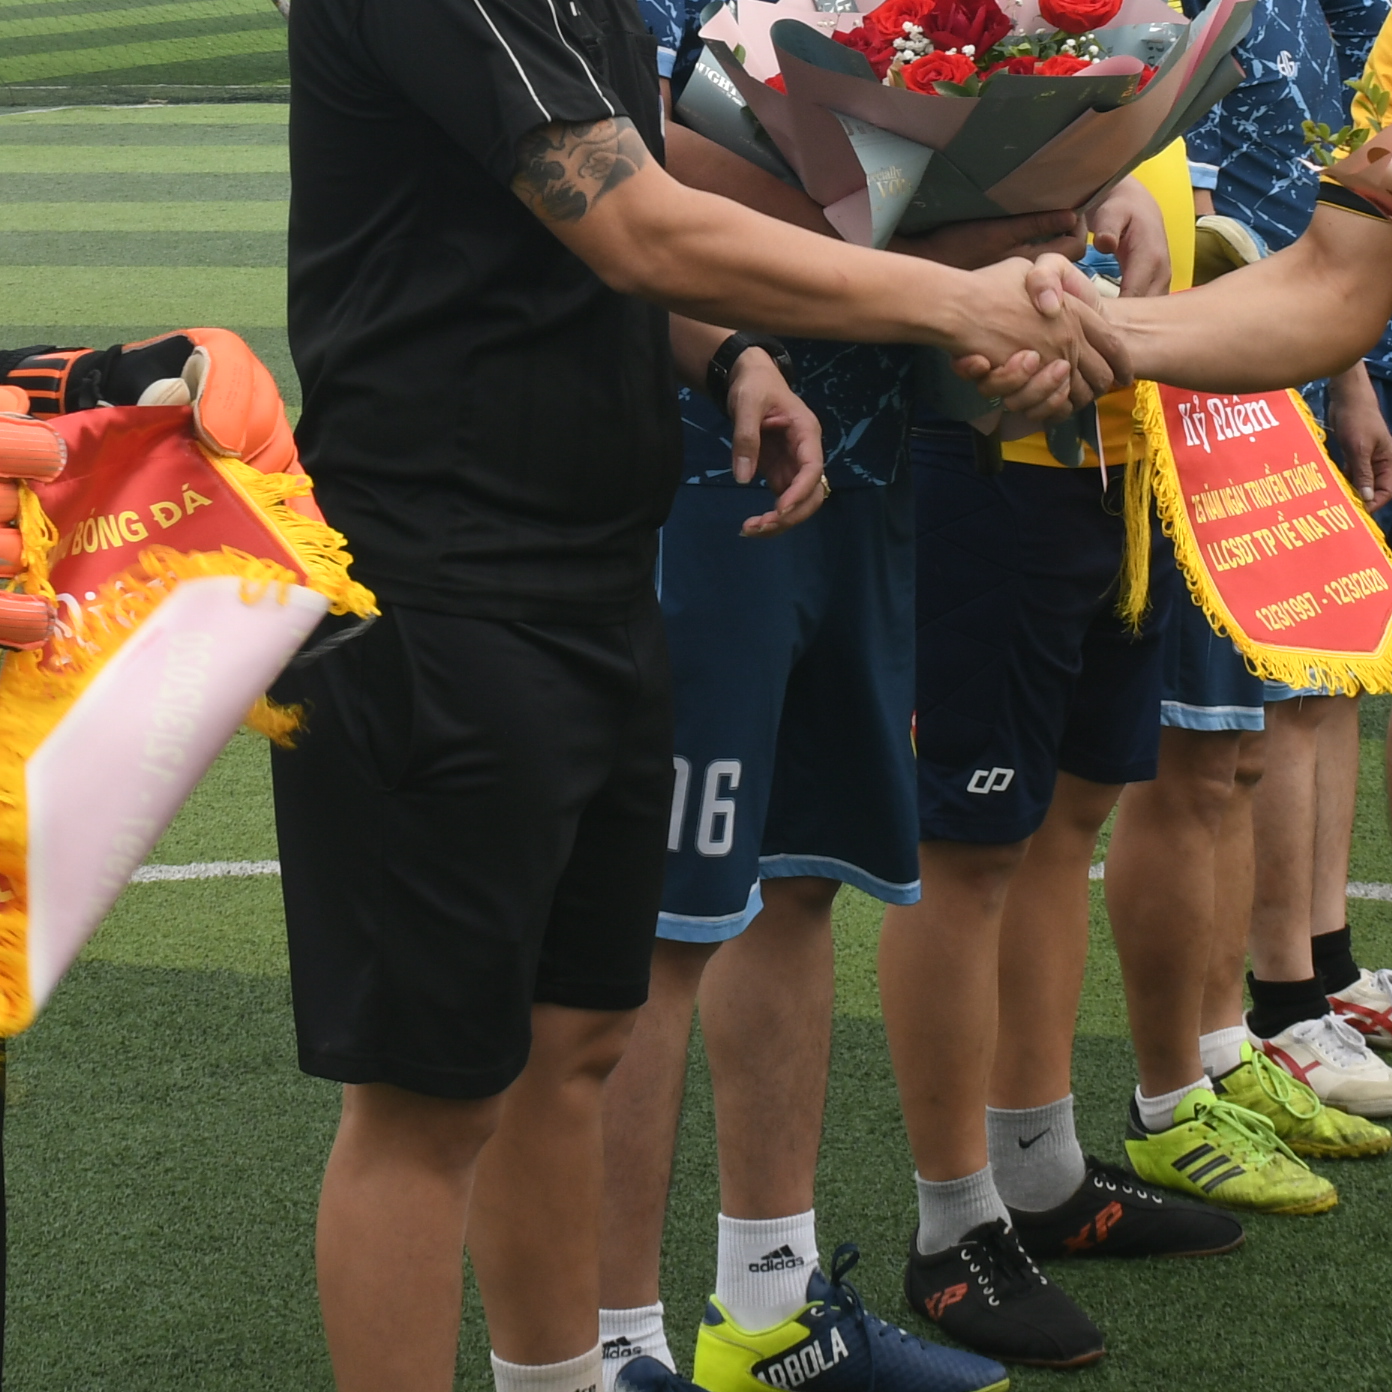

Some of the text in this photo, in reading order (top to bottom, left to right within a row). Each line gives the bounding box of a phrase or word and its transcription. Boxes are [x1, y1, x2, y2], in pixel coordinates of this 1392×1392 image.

[71, 508, 149, 555] BÓNG
[149, 483, 213, 529] ĐÁ
[1252, 528, 1278, 557] TP
[1271, 510, 1304, 550] VỀ
[1292, 514, 1331, 543] MA
[1316, 500, 1355, 533] TÚY
[1255, 590, 1323, 631] 12/3/1997
[1324, 567, 1390, 606] 12/3/2020
[667, 754, 742, 858] 16
[748, 1255, 805, 1274] adidas
